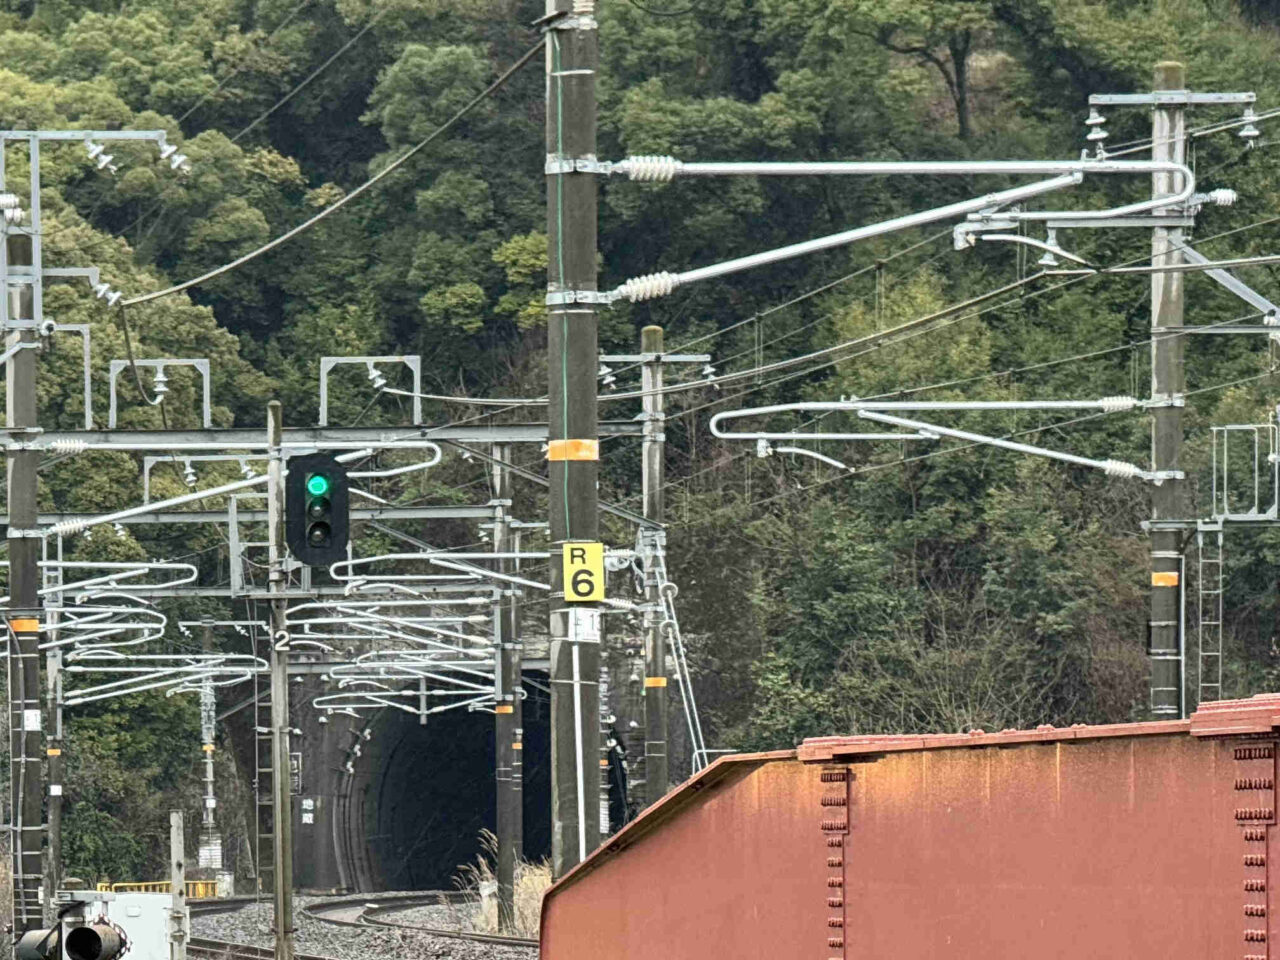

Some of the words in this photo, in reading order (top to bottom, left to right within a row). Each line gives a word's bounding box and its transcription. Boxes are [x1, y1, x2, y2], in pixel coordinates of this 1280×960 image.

[570, 547, 587, 565] R
[571, 569, 595, 598] 6
[275, 630, 290, 651] 2
